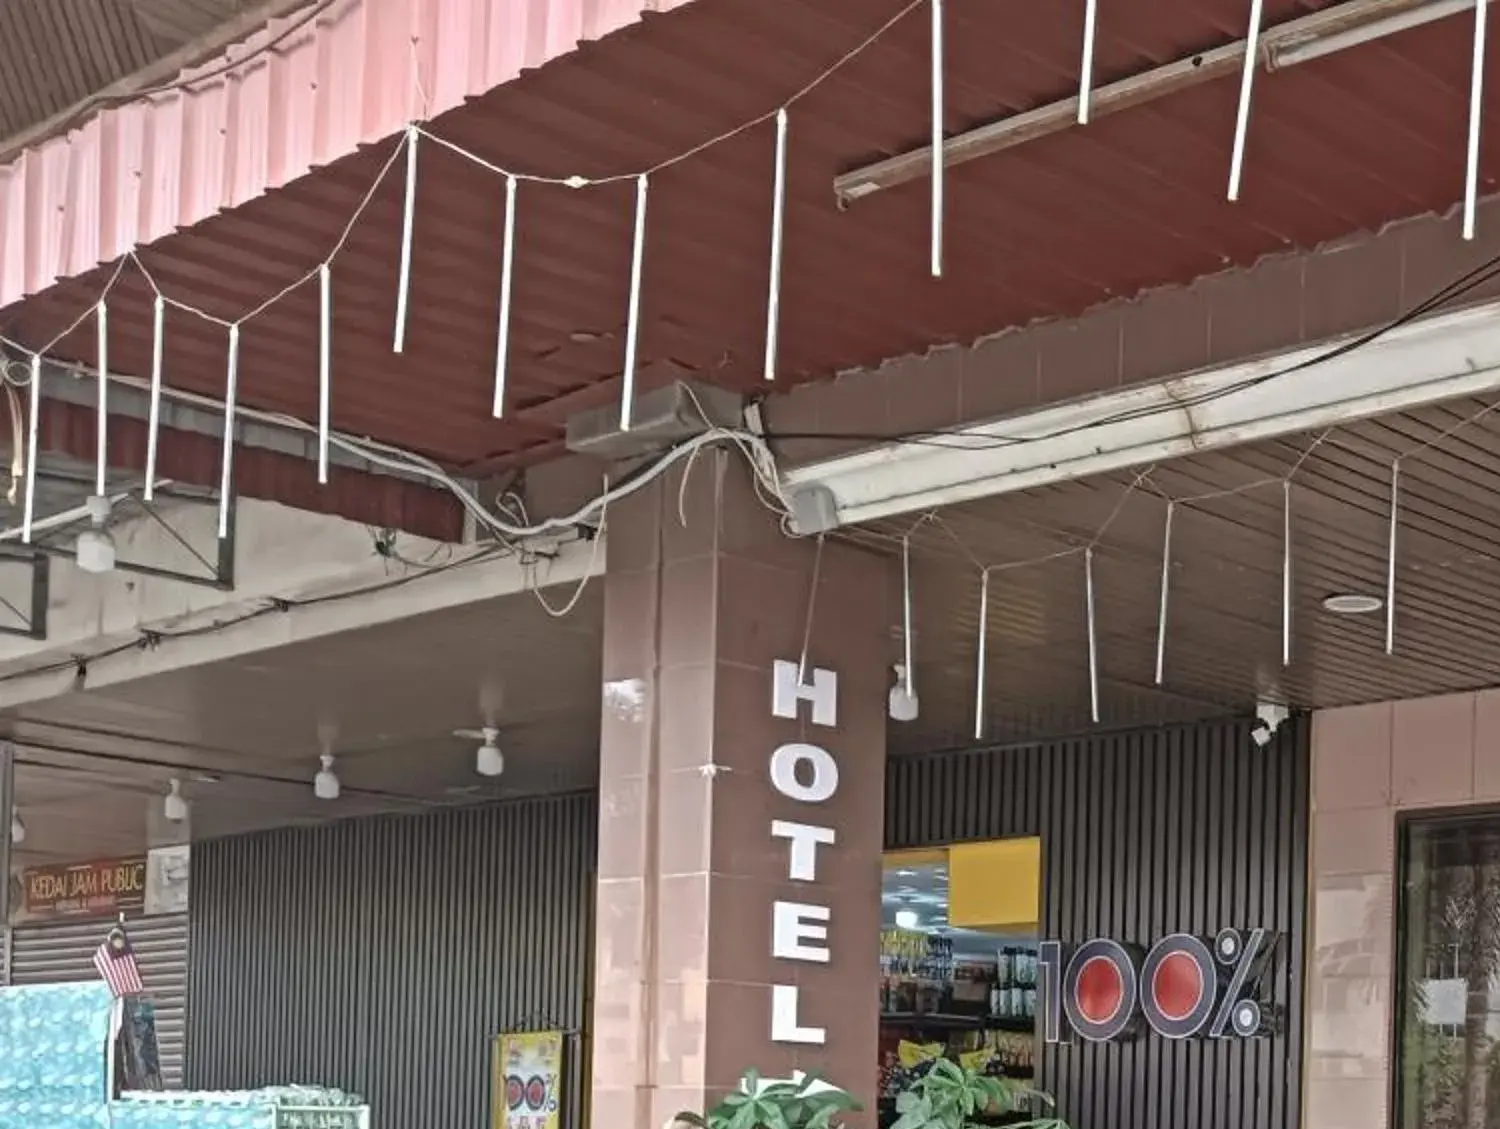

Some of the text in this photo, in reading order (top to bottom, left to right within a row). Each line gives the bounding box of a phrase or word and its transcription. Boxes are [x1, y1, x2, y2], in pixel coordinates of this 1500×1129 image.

[30, 873, 68, 900] KEDAI
[70, 869, 98, 897] JAM
[771, 659, 840, 1045] HOTEL
[1038, 927, 1266, 1044] 100%
[503, 1073, 558, 1112] 00%
